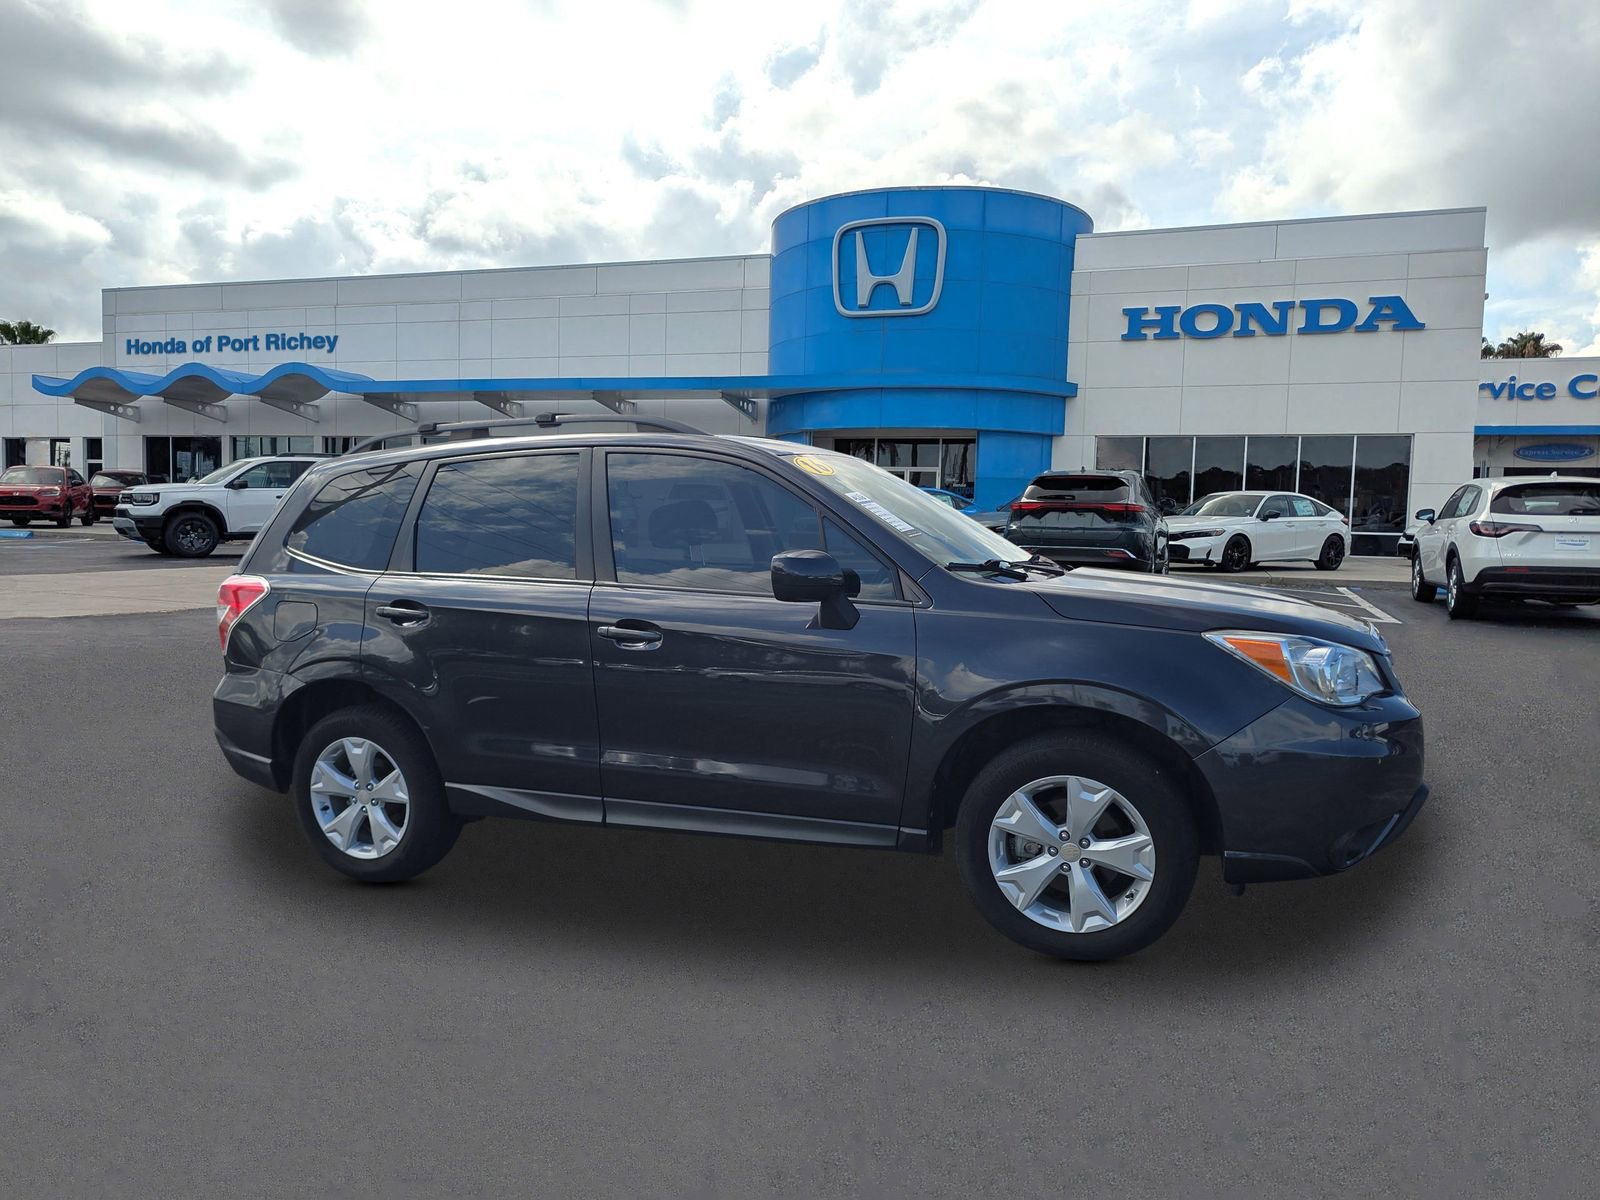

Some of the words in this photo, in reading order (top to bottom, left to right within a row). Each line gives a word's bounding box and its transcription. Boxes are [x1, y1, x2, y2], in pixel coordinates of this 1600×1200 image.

[1121, 296, 1426, 341] HONDA
[126, 338, 187, 355] Honda
[192, 336, 212, 353] of
[217, 335, 260, 352] Port
[265, 333, 339, 354] Richey
